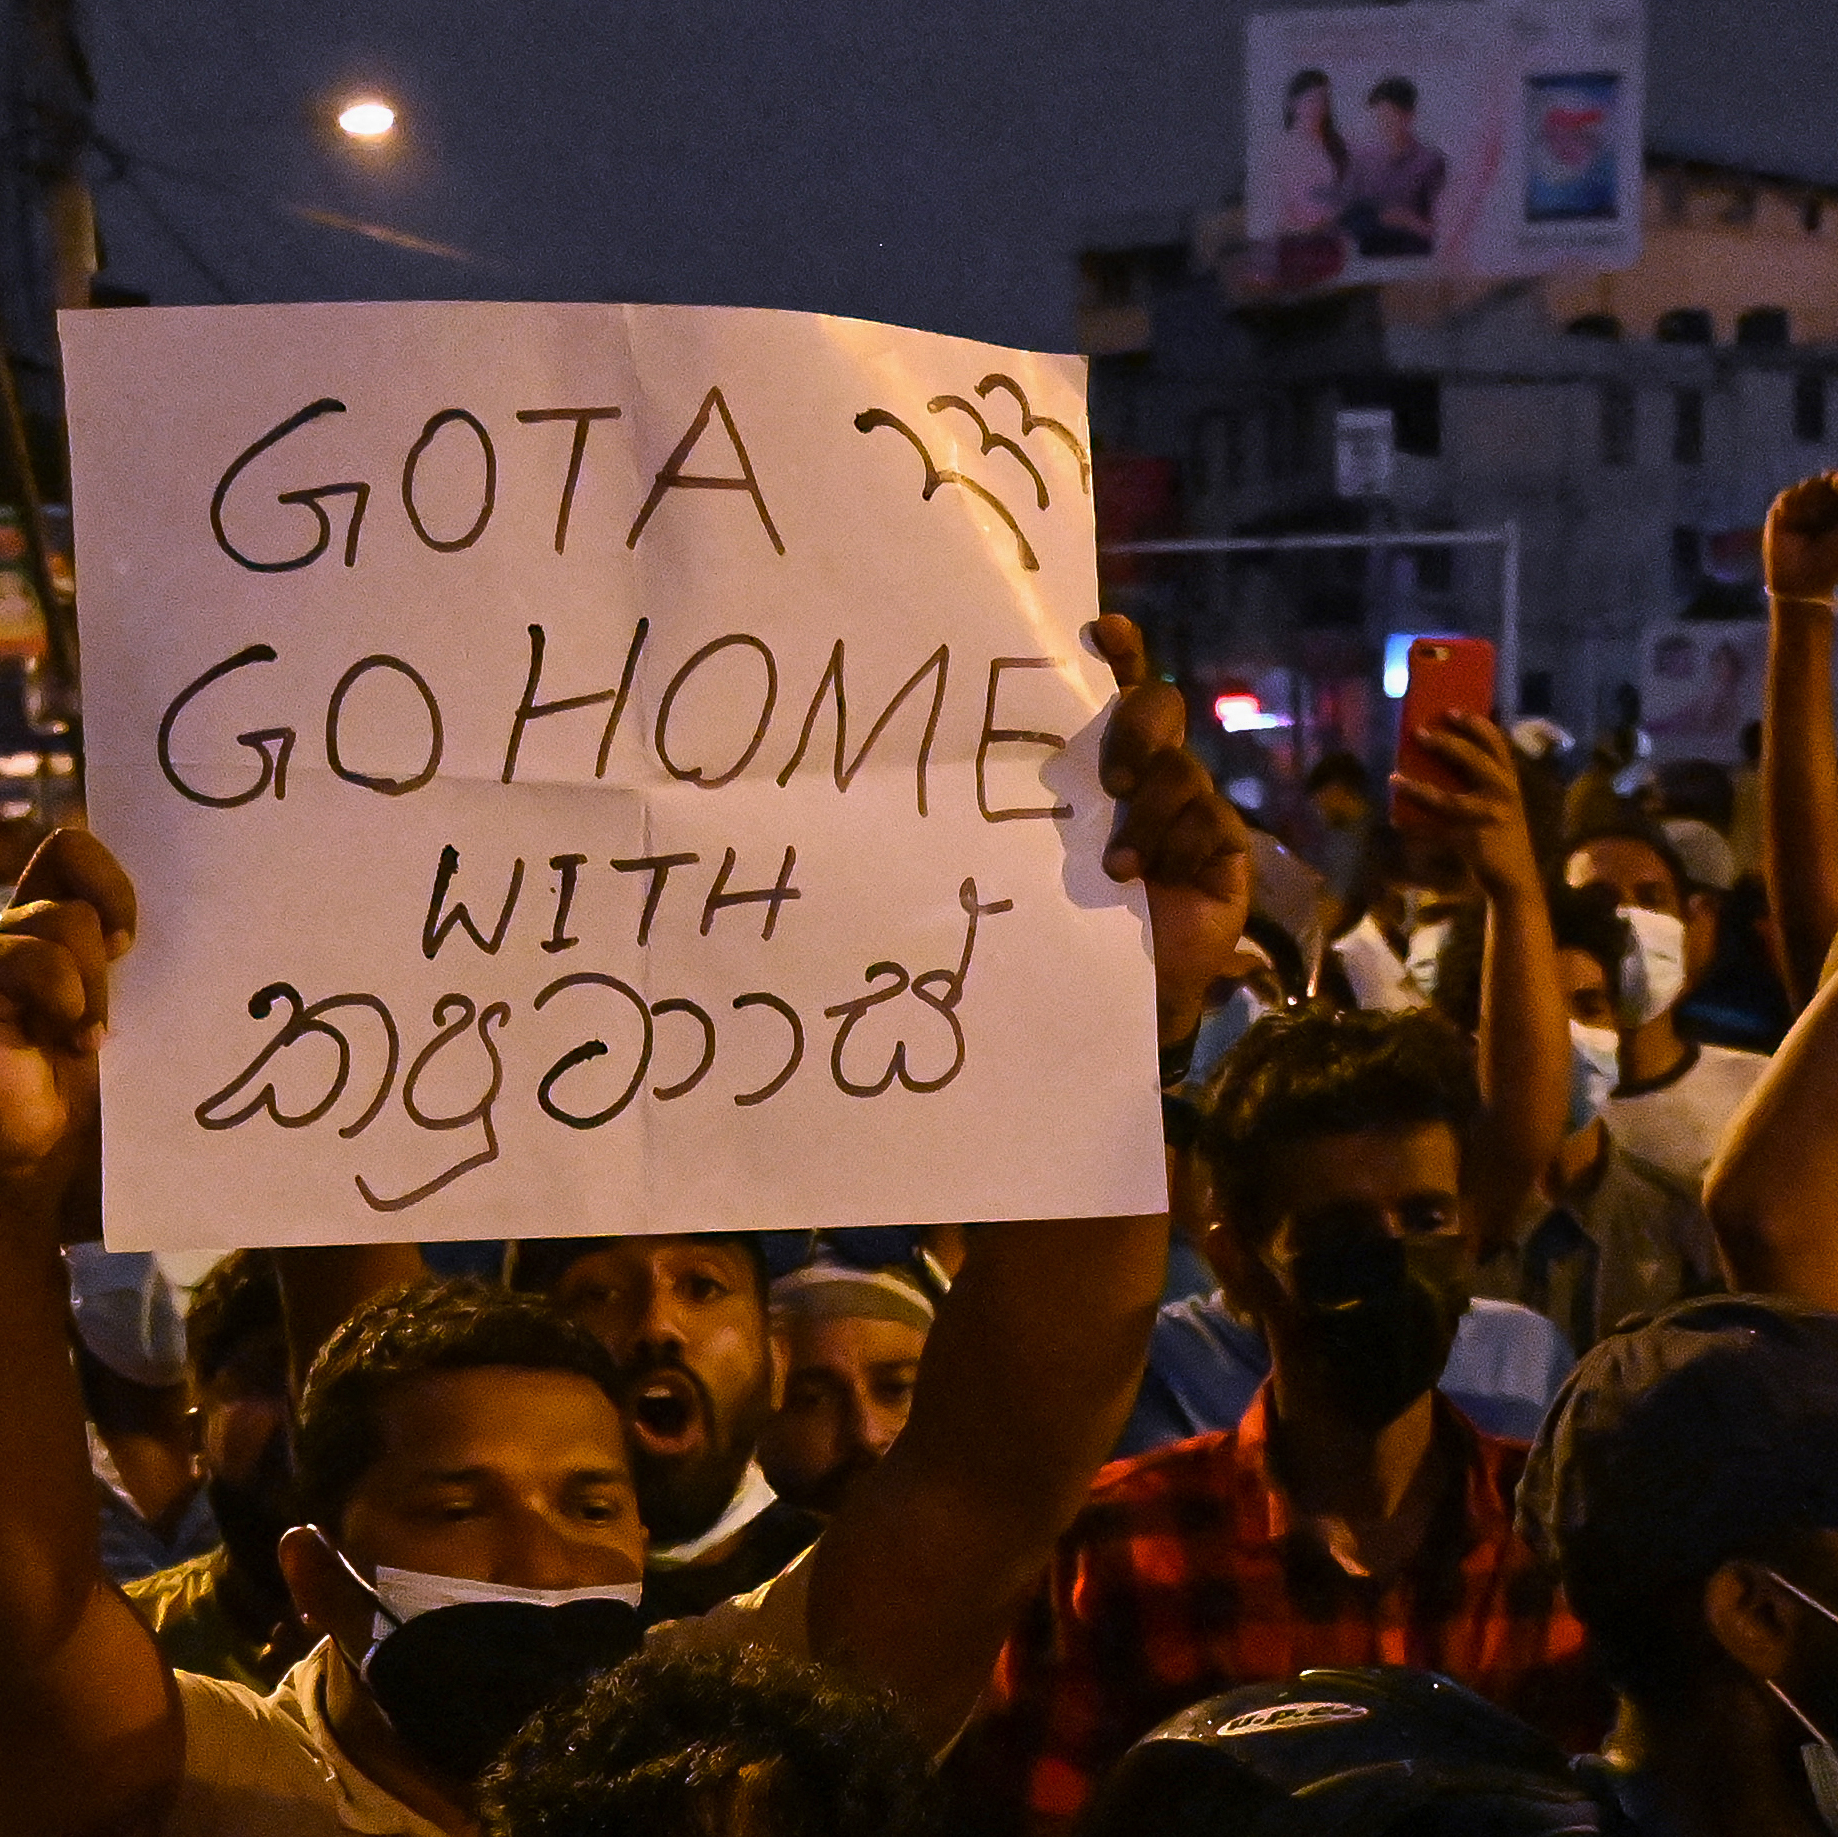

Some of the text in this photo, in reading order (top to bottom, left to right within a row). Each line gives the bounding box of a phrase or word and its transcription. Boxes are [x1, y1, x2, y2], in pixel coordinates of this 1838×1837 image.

[209, 386, 787, 575] GOTA
[156, 616, 1075, 822] GO HOME
[420, 843, 802, 962] WITH
